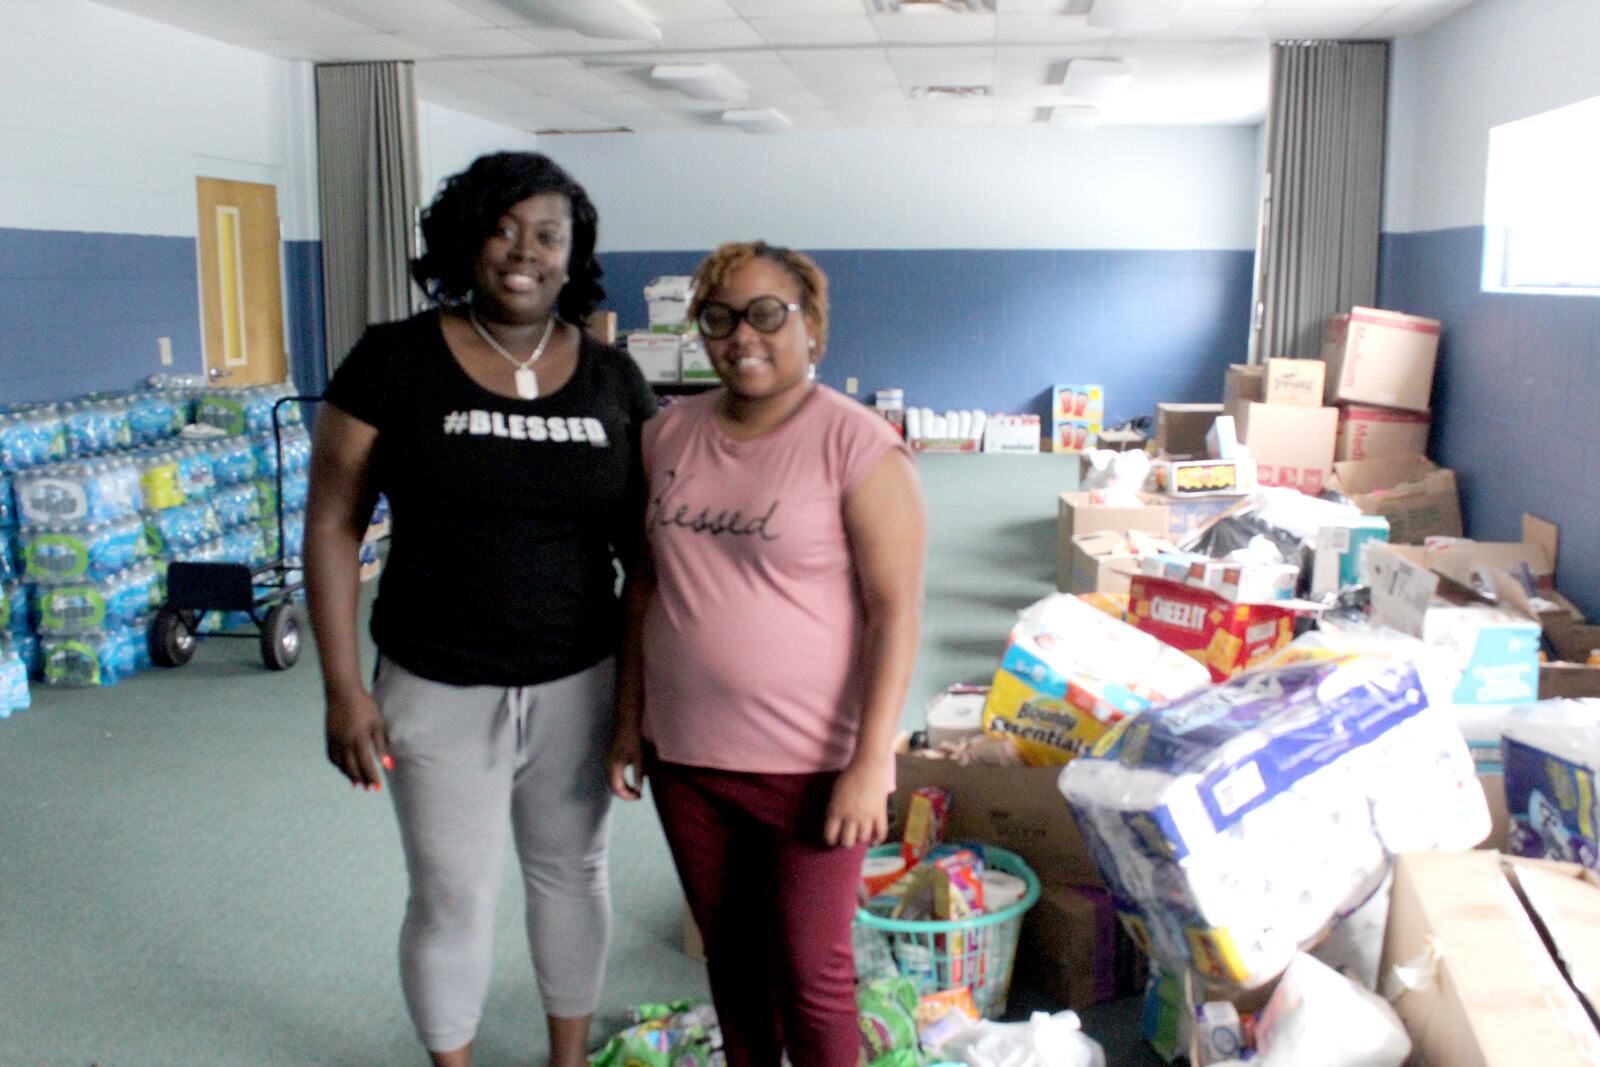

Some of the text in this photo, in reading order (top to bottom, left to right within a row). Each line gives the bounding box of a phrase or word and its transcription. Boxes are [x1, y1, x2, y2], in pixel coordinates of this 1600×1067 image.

[1345, 325, 1367, 388] Medium
[443, 409, 609, 447] #BLESSED
[653, 470, 780, 541] lessed
